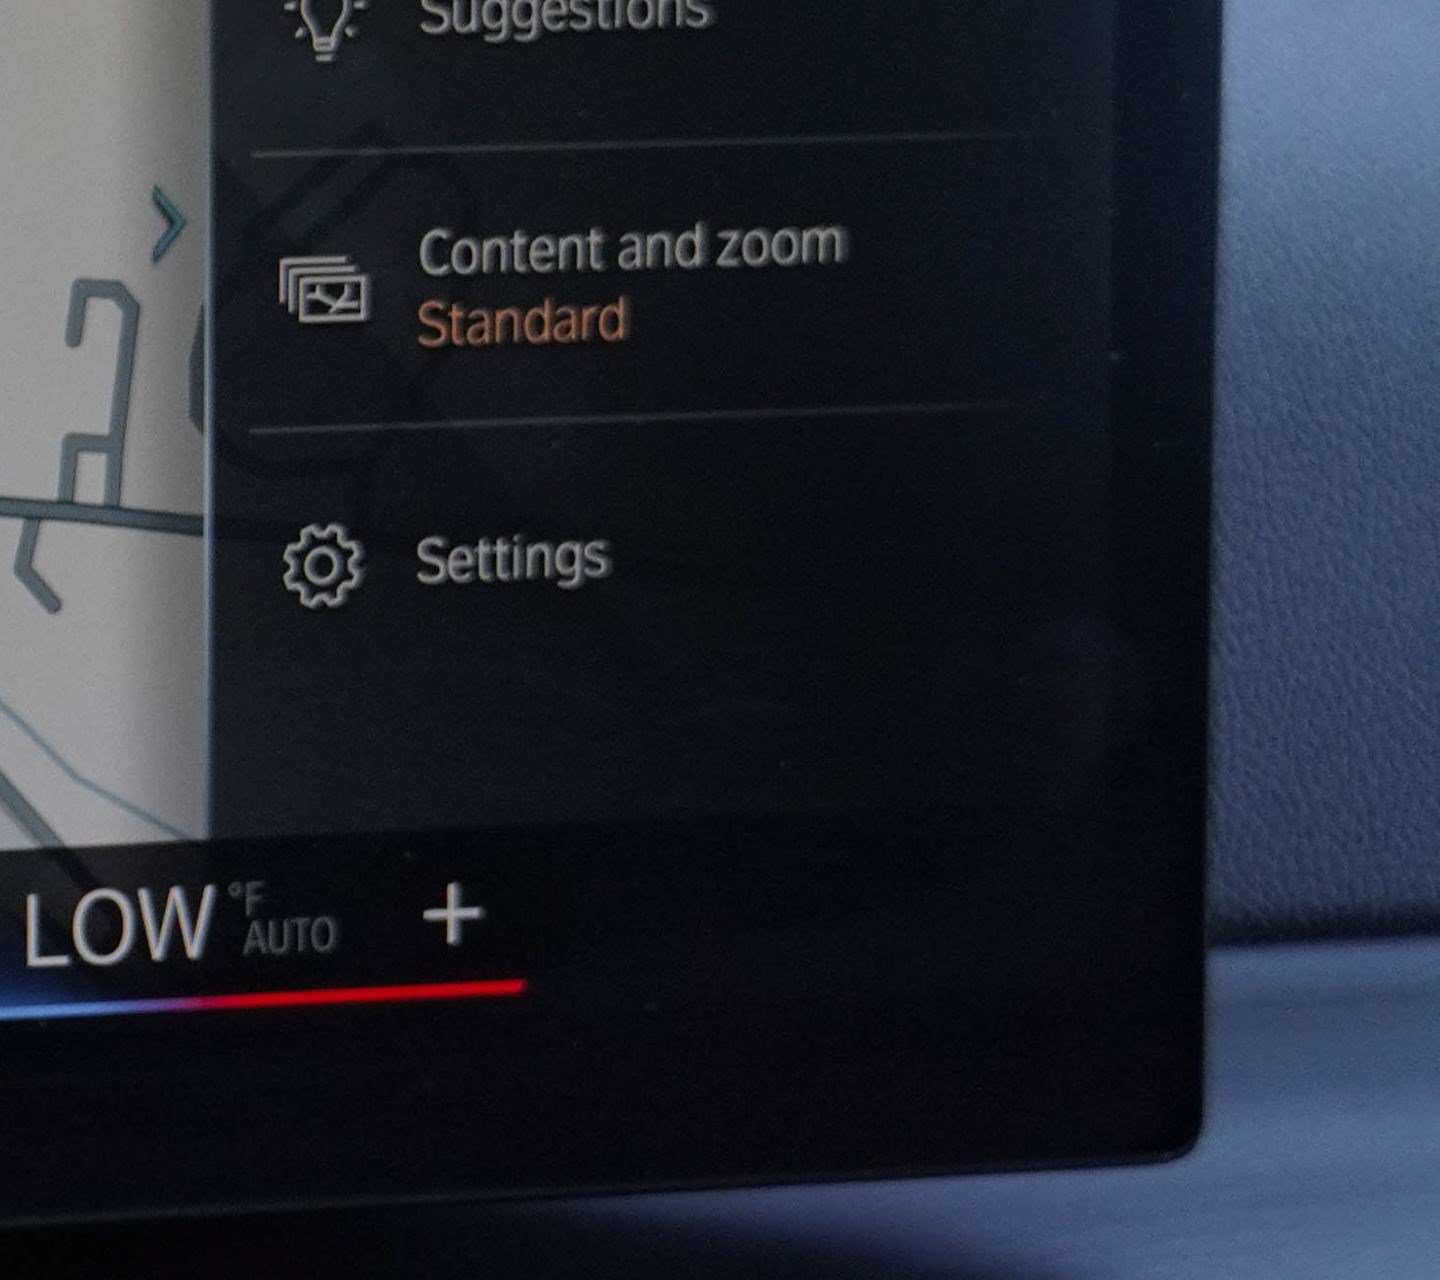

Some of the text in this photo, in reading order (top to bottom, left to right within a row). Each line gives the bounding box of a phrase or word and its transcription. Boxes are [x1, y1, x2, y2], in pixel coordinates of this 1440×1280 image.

[418, 221, 848, 277] Content and zoom
[417, 295, 630, 348] Standard
[416, 534, 611, 590] Settings
[25, 883, 216, 969] LOW
[242, 917, 337, 955] AUTO
